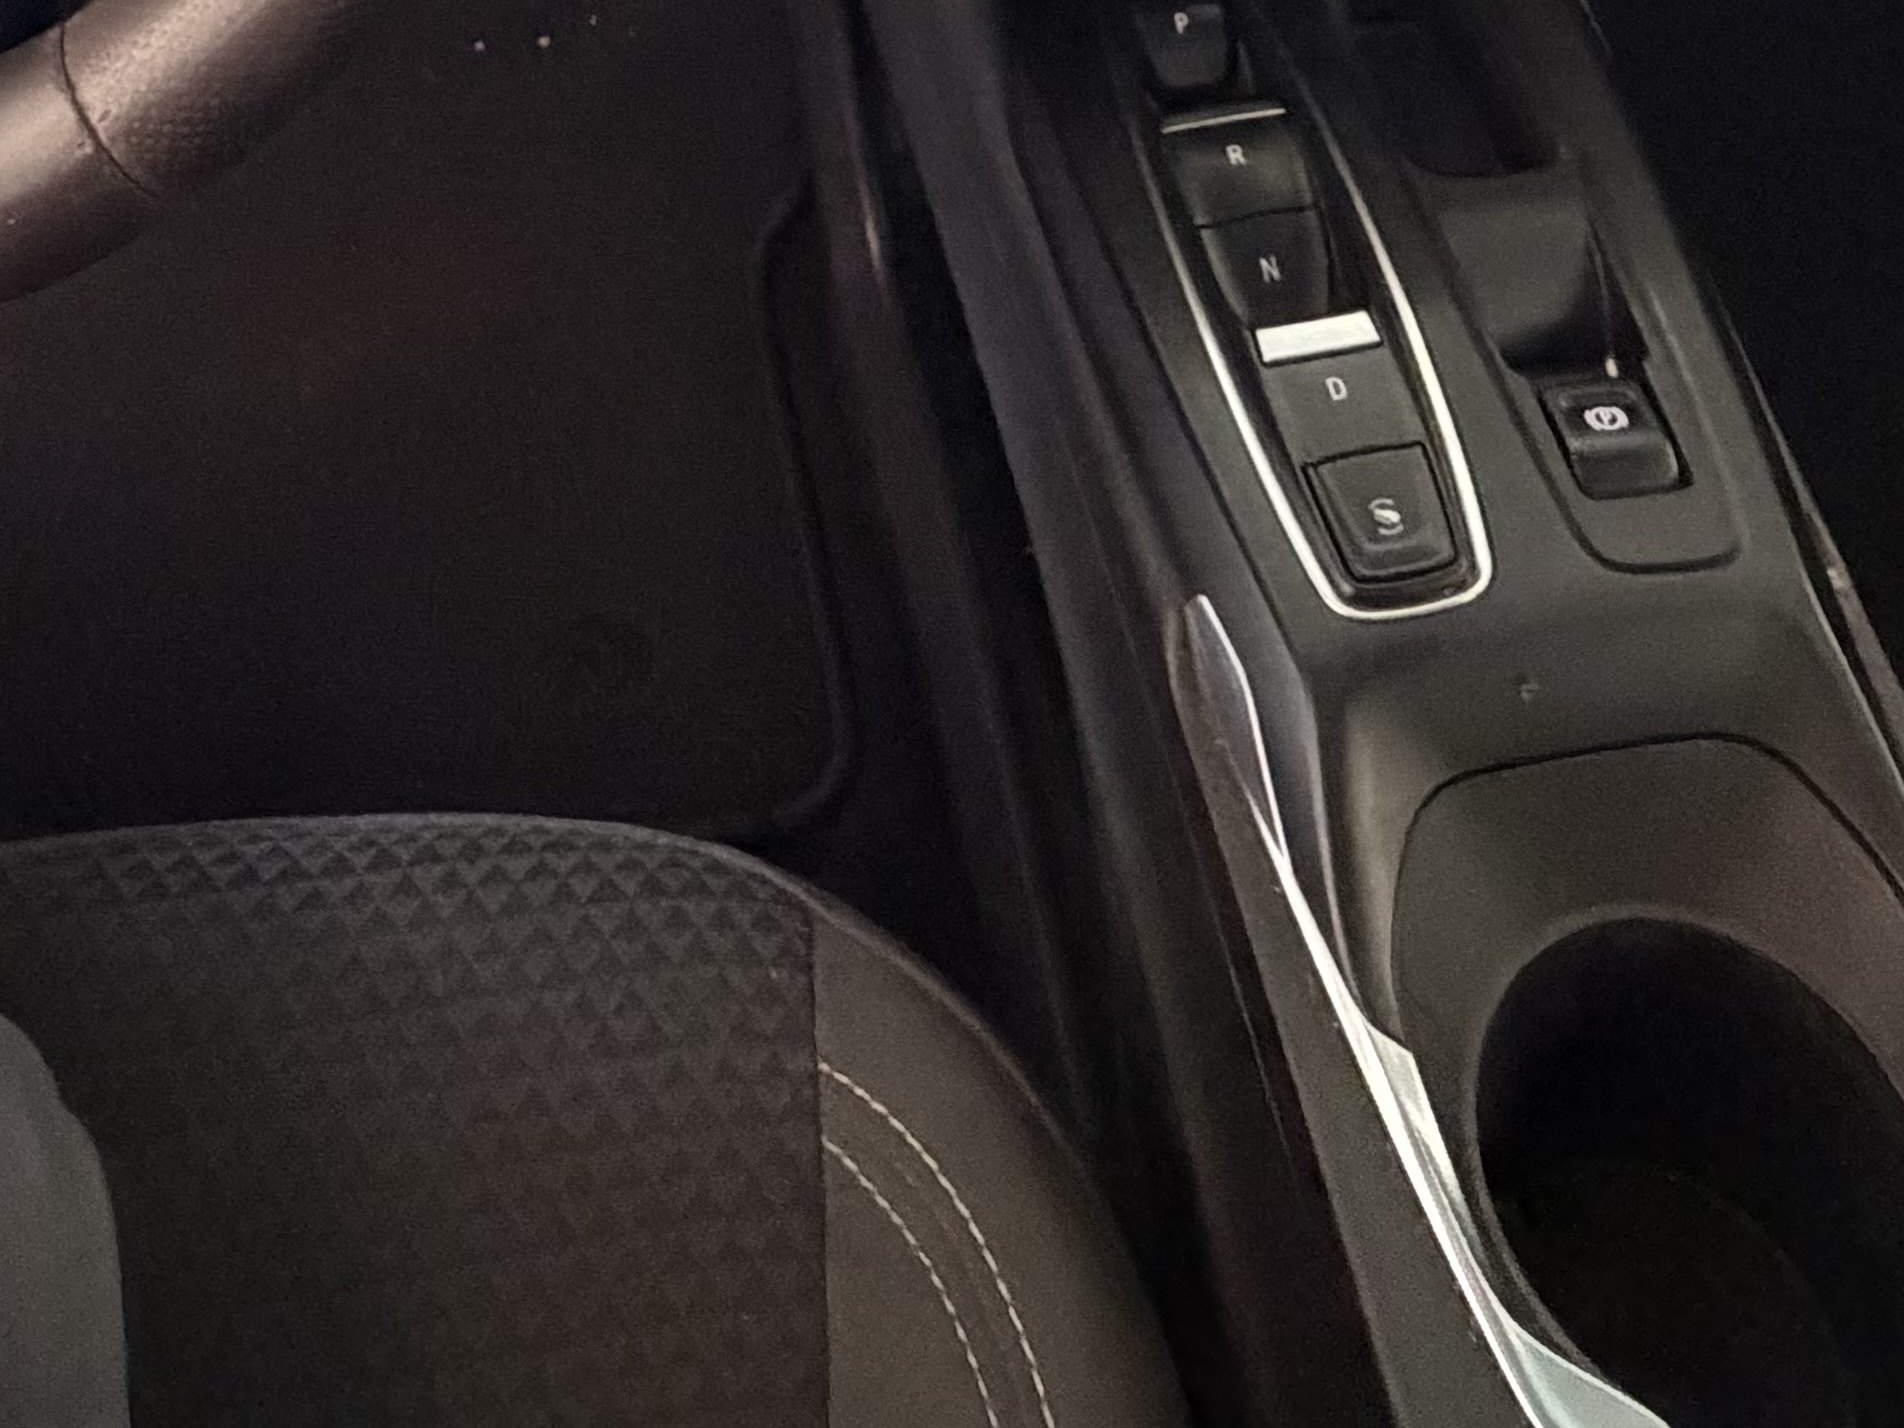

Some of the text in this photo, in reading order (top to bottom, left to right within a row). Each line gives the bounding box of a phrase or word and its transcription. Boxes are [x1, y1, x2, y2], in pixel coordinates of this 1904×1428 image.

[1174, 12, 1189, 34] P
[1225, 145, 1245, 165] R
[1259, 254, 1282, 283] N
[1325, 376, 1348, 402] D
